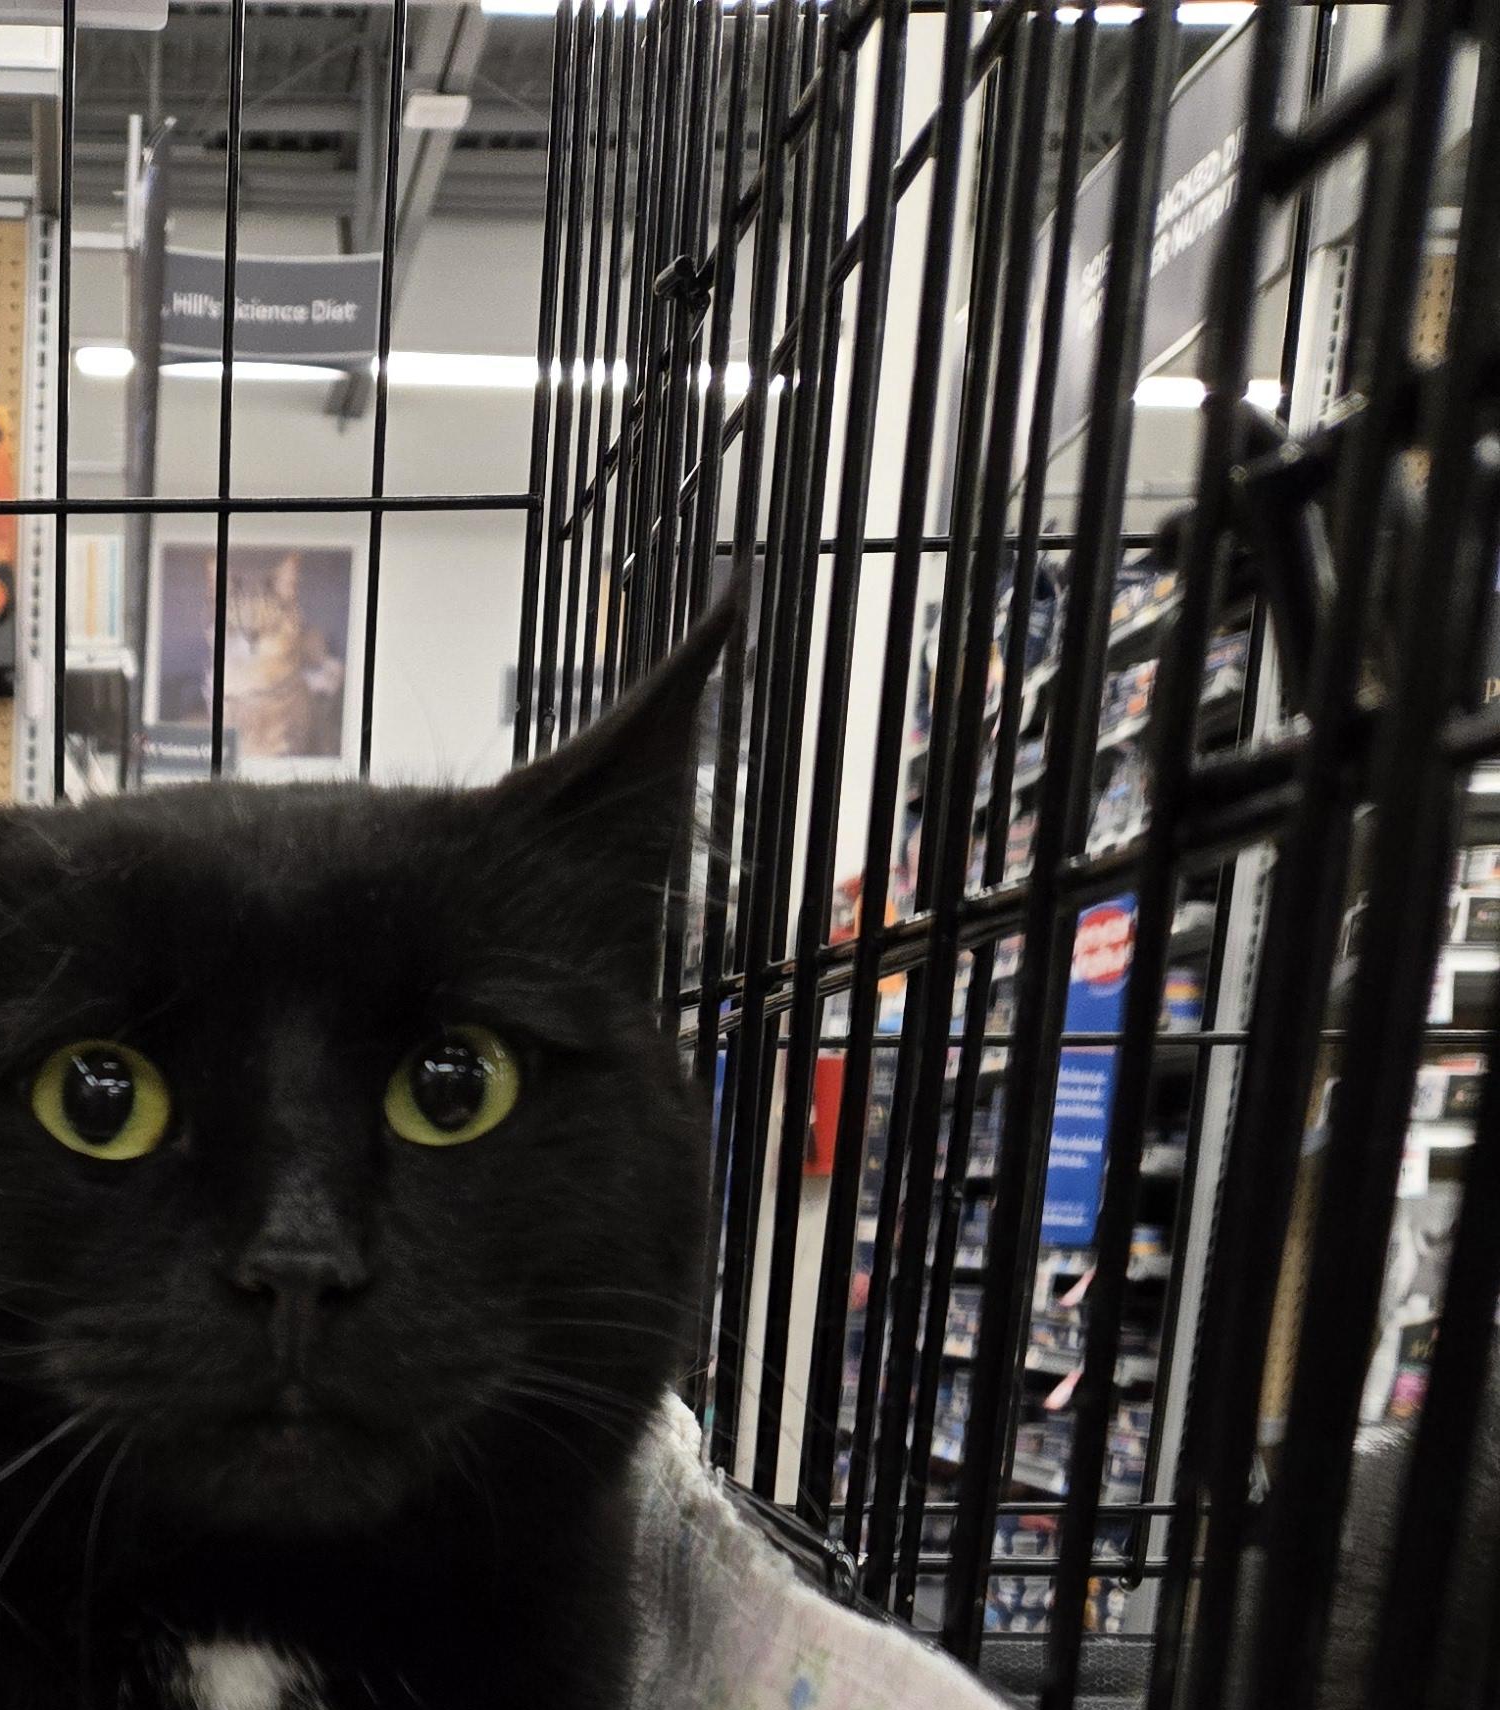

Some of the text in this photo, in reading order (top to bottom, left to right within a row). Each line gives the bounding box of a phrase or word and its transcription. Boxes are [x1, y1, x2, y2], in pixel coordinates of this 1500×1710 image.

[173, 292, 222, 319] Hill's
[233, 295, 309, 323] cience
[311, 298, 358, 324] Diet
